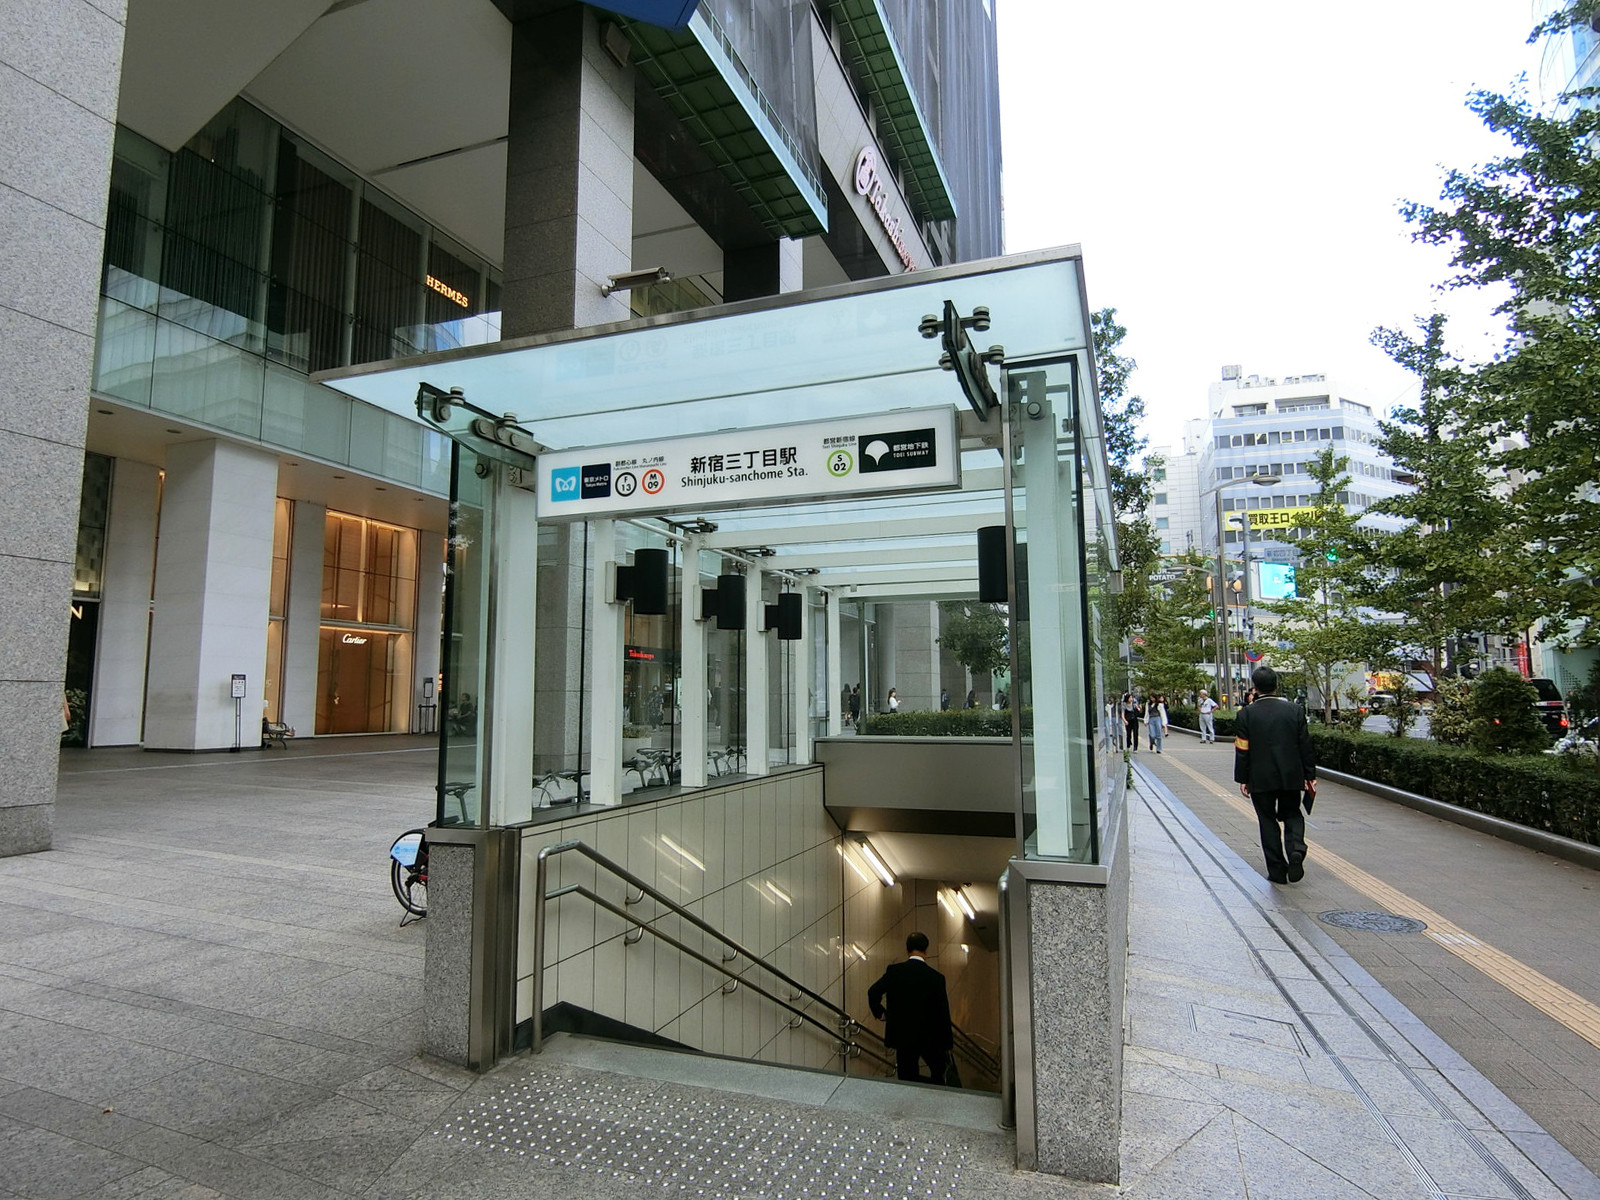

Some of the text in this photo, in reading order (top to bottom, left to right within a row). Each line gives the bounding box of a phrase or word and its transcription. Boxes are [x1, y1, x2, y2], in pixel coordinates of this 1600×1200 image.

[893, 441, 929, 452] 都営地下鉄
[906, 449, 929, 457] SUBWAY
[690, 446, 797, 474] 新宿三丁目駅
[837, 454, 843, 462] S
[833, 463, 847, 471] 02
[681, 466, 808, 488] Shinjuku-sanchome Sta.
[621, 483, 632, 492] 13
[647, 481, 659, 489] 09
[342, 633, 367, 645] Cartier
